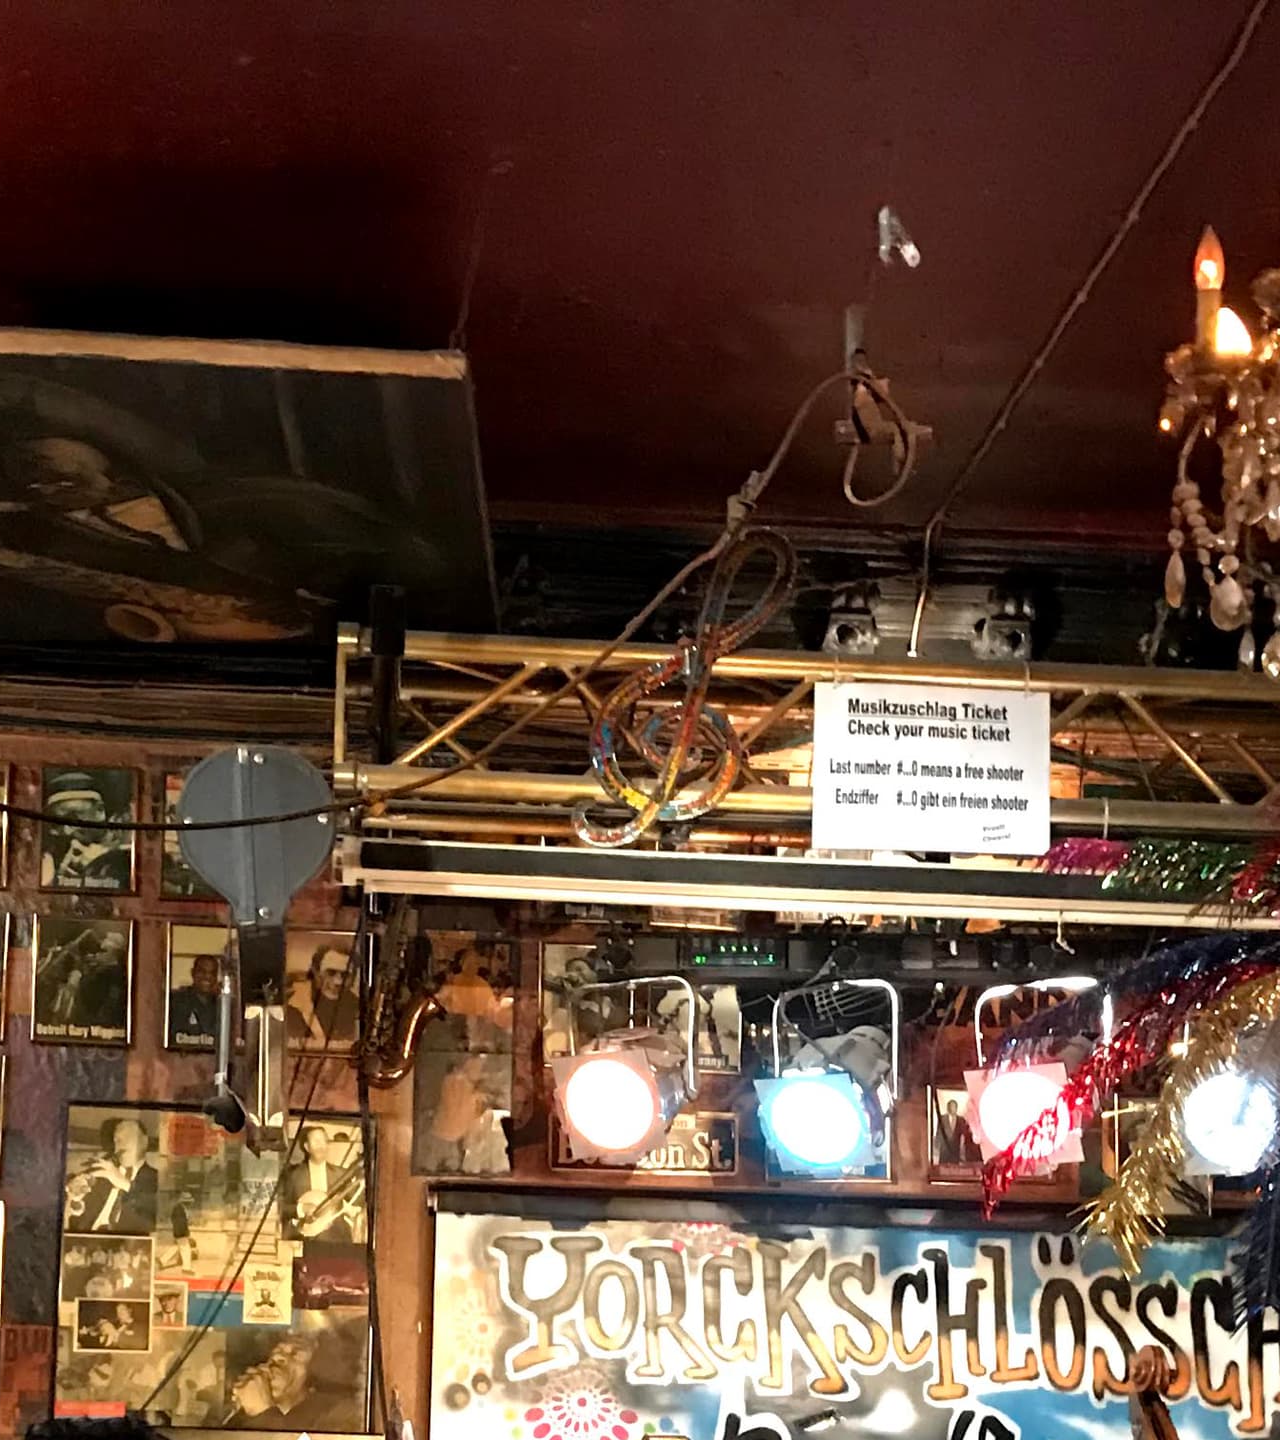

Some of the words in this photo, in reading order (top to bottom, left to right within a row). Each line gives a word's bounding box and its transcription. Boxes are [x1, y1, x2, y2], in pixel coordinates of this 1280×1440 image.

[848, 699, 957, 721] Musikzuschlag
[961, 703, 1008, 720] Ticket
[848, 719, 890, 736] Check
[894, 723, 924, 740] your
[928, 723, 968, 739] music
[972, 726, 1010, 742] ticket
[830, 758, 851, 774] Last
[854, 760, 891, 776] number
[920, 764, 953, 778] means
[955, 766, 962, 778] a
[964, 764, 984, 780] free
[986, 765, 1024, 781] shooter
[835, 788, 879, 805] Endziffer
[920, 792, 940, 810] gibt
[942, 793, 957, 808] ein
[959, 793, 989, 809] freien
[991, 795, 1028, 811] shooter
